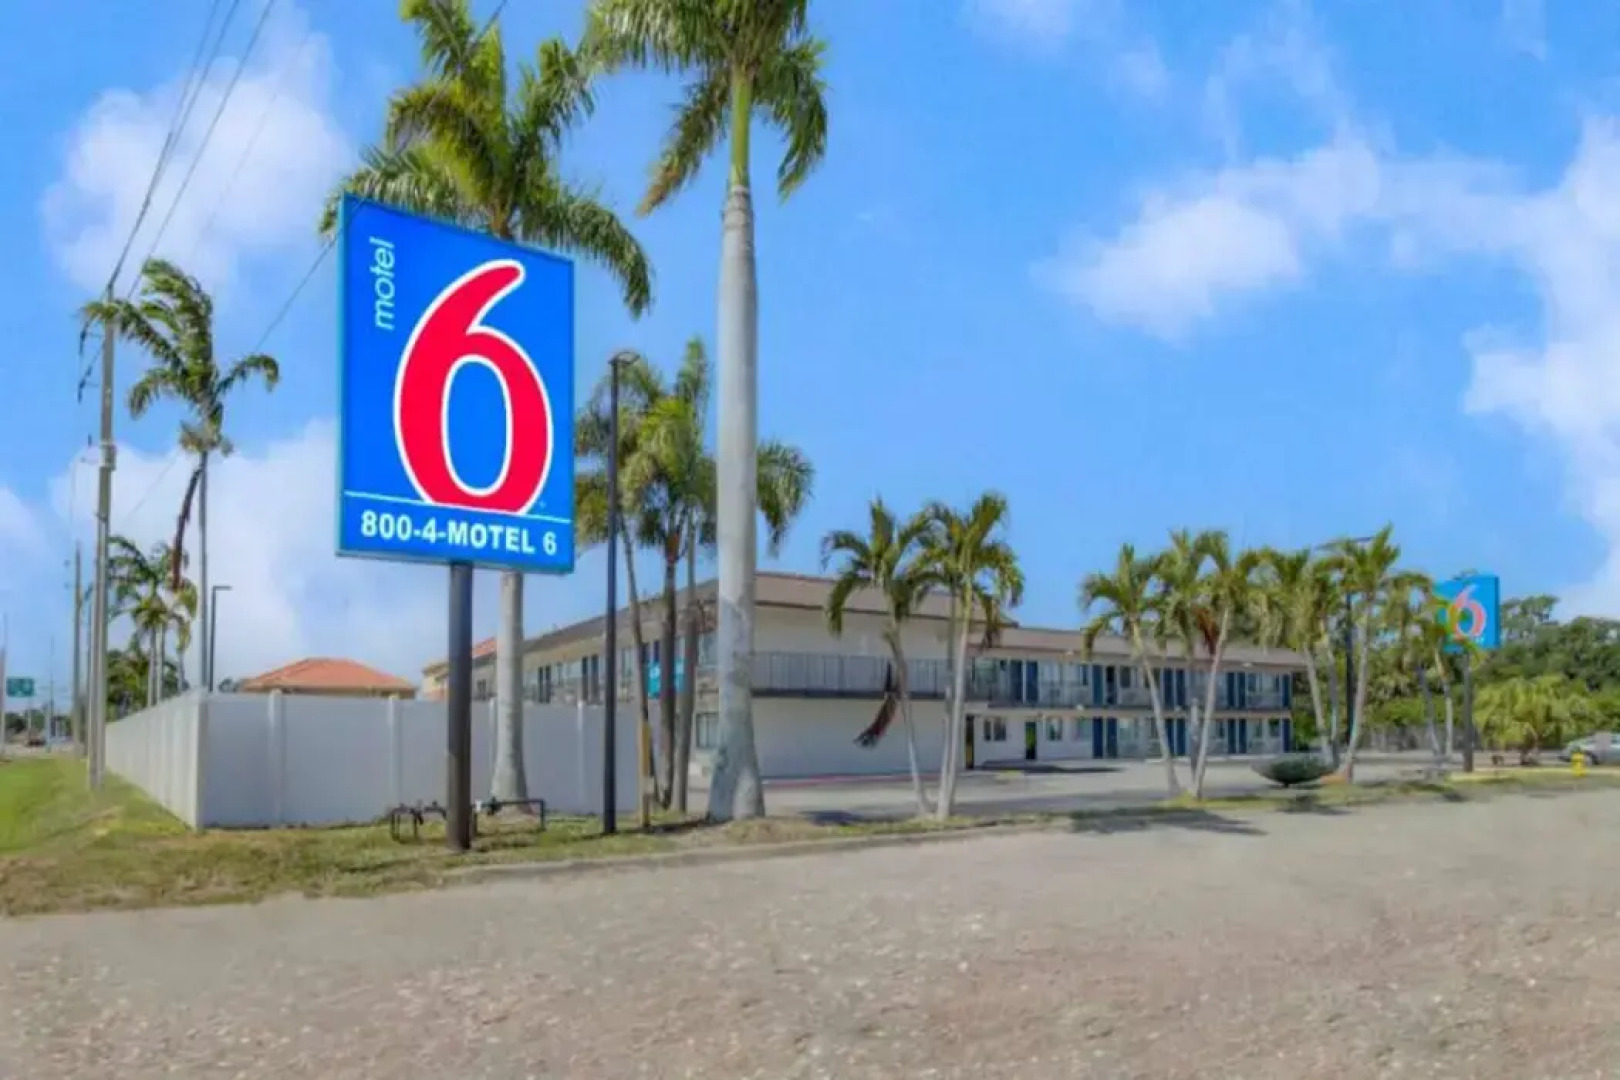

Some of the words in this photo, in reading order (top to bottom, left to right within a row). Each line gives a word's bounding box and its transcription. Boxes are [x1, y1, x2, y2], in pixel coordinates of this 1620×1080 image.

[369, 237, 396, 331] motel
[393, 259, 554, 515] 6
[360, 509, 535, 553] 800-4-MOTEL
[542, 531, 558, 556] 6
